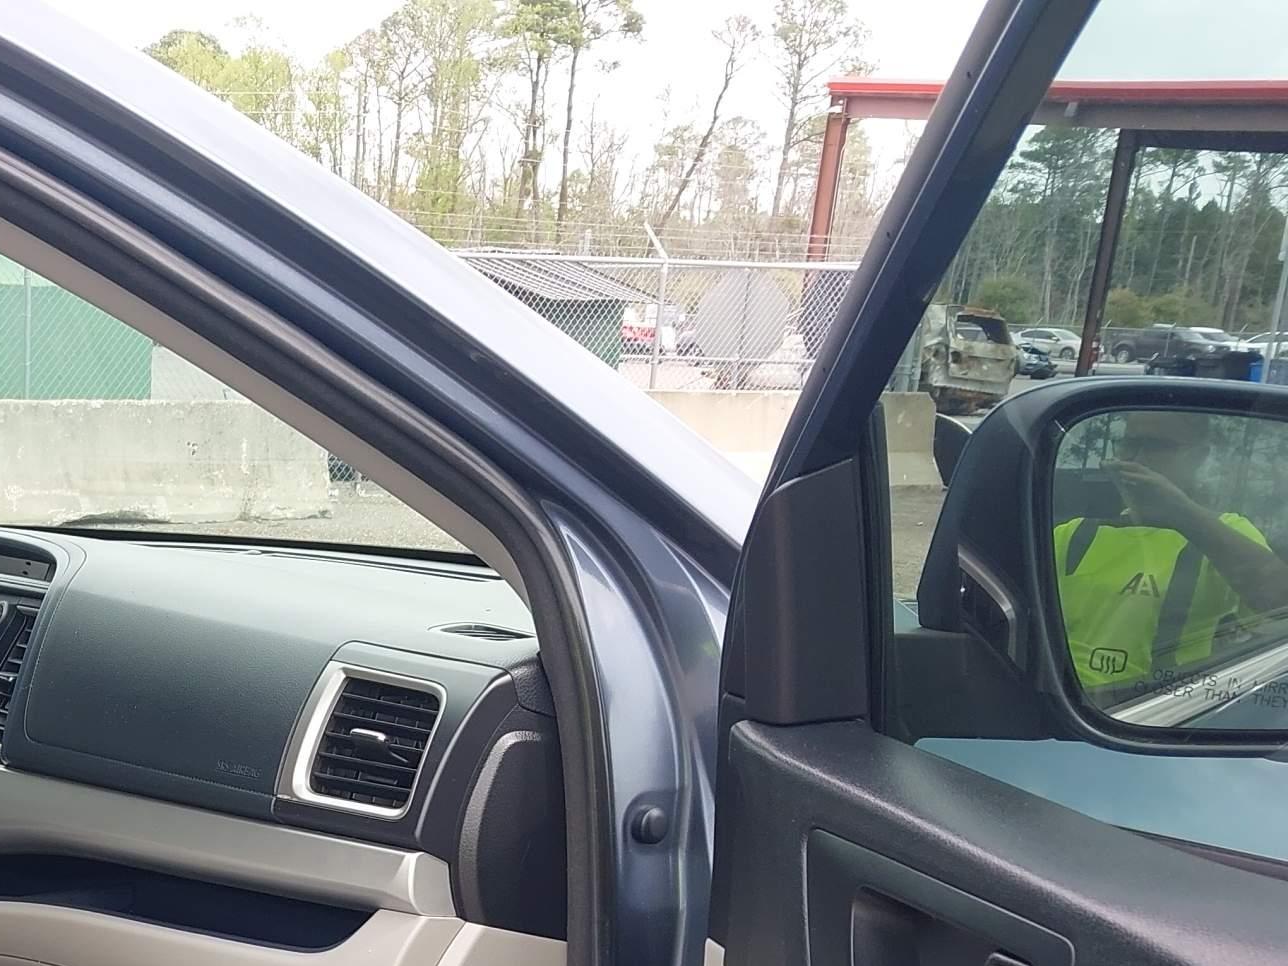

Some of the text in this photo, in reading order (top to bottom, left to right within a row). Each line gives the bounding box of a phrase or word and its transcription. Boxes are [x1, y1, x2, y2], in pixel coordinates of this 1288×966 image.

[1153, 668, 1218, 687] OBJECTS
[1227, 677, 1241, 690] IN
[1203, 687, 1241, 704] THAN
